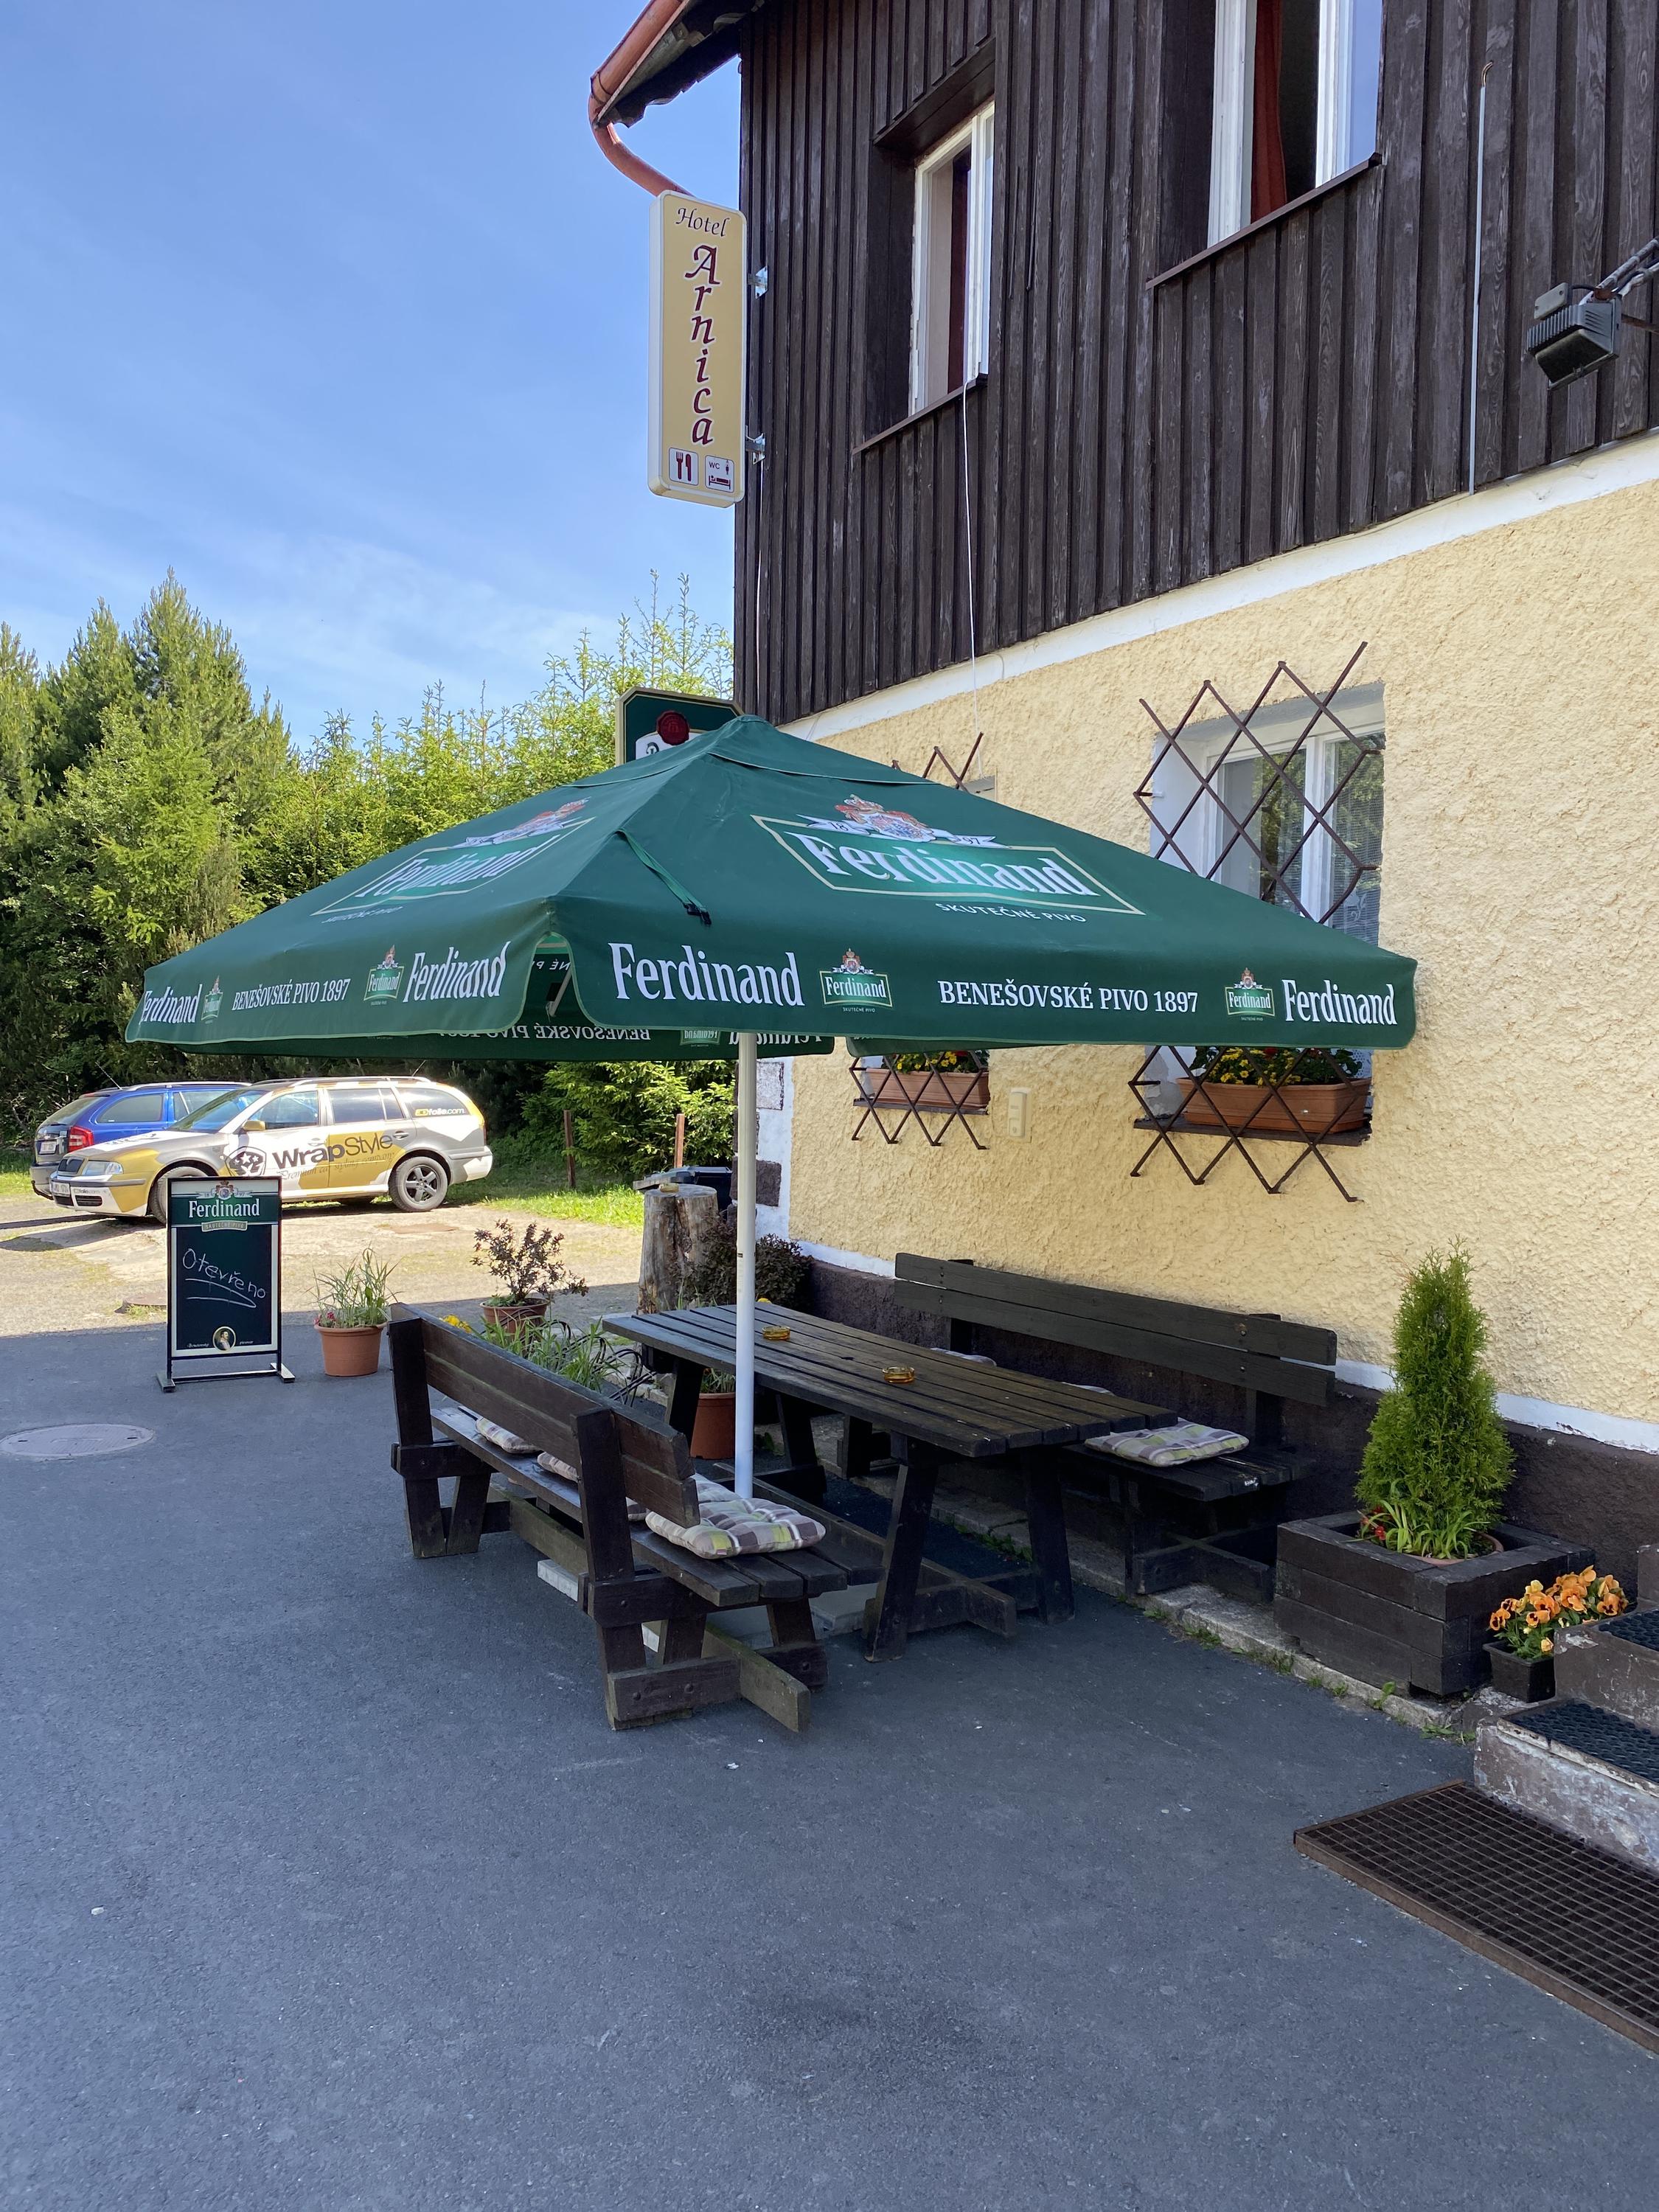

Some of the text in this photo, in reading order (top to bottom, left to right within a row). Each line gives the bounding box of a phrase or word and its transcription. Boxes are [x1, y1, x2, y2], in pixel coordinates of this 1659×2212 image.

[675, 207, 730, 237] Hotel
[684, 245, 720, 445] Arnica
[709, 462, 720, 470] WC
[966, 837, 981, 845] 97
[784, 831, 1101, 897] Ferdinand
[935, 902, 1087, 922] SKUTEČNÉ PIVO
[368, 972, 400, 992] Ferdinand
[403, 941, 511, 1003] Ferdinand
[608, 942, 805, 1006] Ferdinand
[825, 977, 887, 998] Ferdinand
[232, 979, 292, 1011] BENEŠOVSKÉ
[293, 981, 320, 1004] PIVO
[320, 978, 351, 1002] 1897
[937, 979, 1198, 1013] BENEŠOVSKÉ PIVO 1897
[1228, 992, 1271, 1009] Ferdinand
[1281, 979, 1398, 1025] Ferdinand
[271, 1133, 393, 1169] WrapStyle
[189, 1198, 260, 1218] Ferdinand
[183, 1248, 266, 1298] Otevřeno
